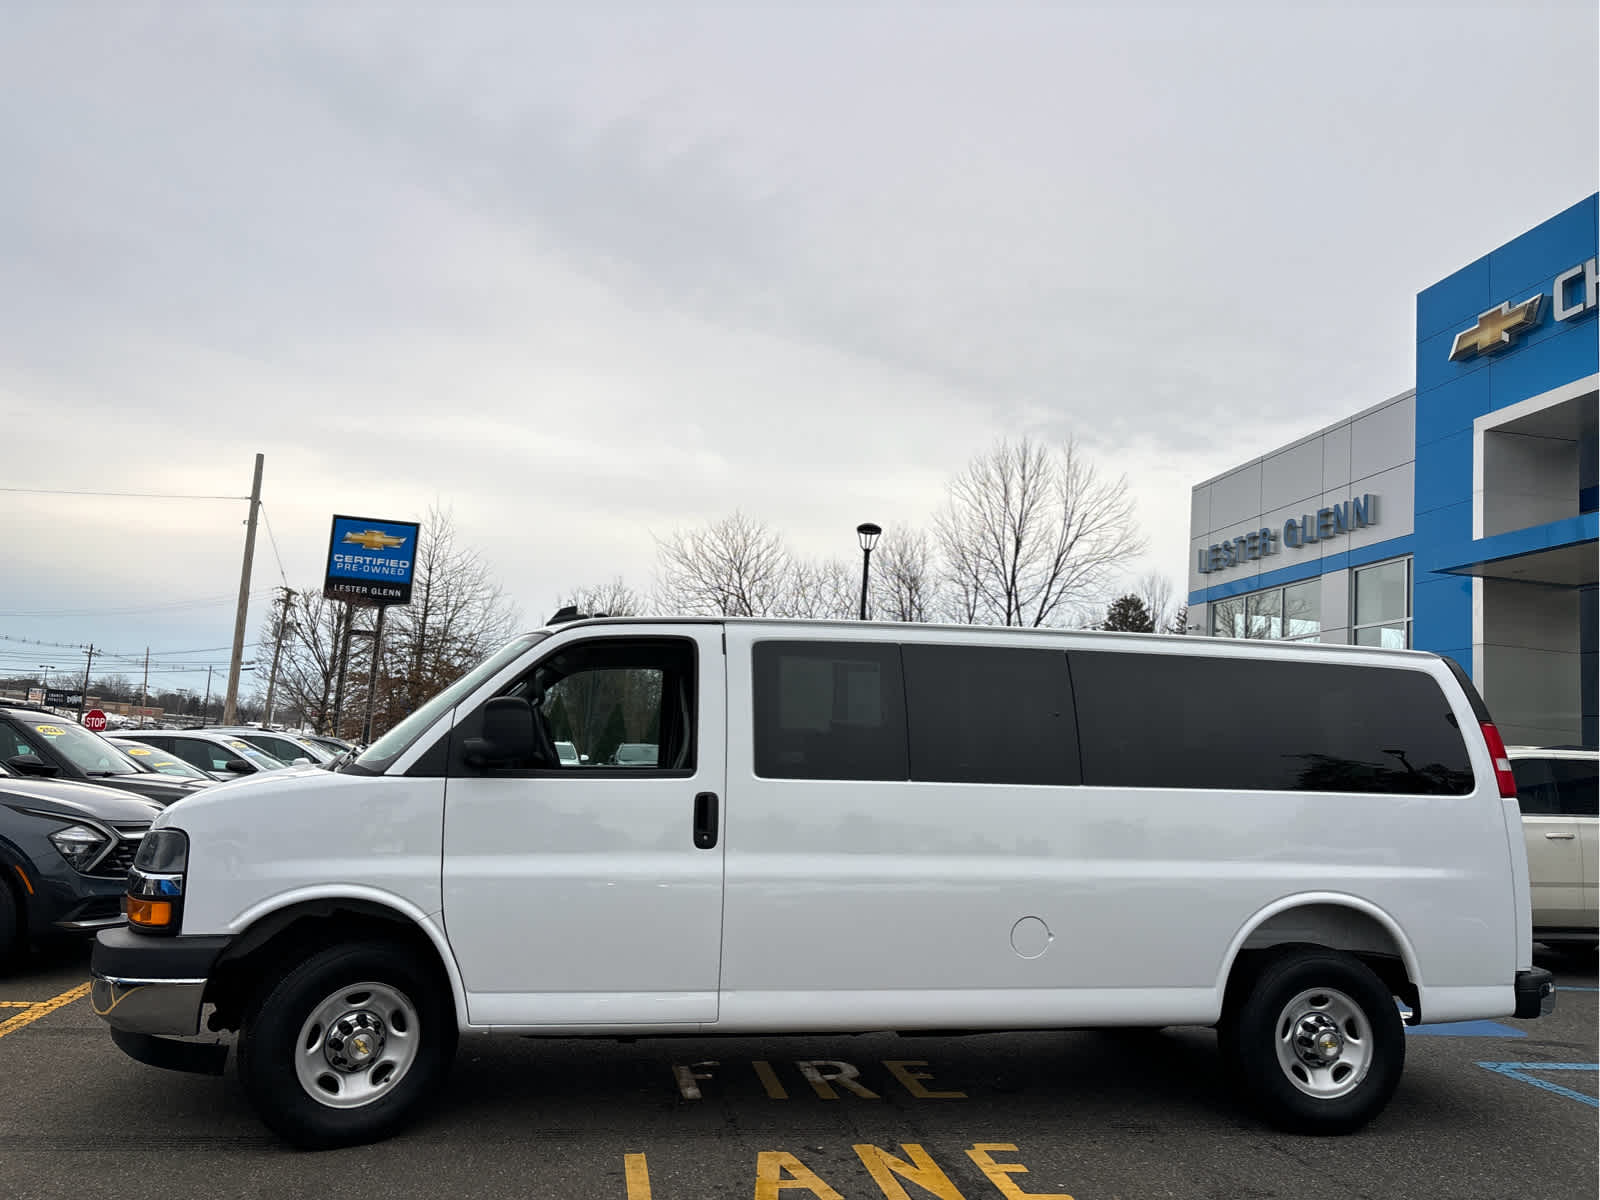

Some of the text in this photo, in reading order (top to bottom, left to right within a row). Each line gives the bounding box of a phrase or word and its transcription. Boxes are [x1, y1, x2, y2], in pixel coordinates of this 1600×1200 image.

[1198, 494, 1377, 573] LESTER GLENN
[334, 554, 409, 568] CERTIFIED
[336, 562, 404, 576] PRE-OWNED
[334, 584, 401, 597] LESTER GLENN
[86, 717, 106, 728] STOP
[673, 1060, 968, 1099] FIRE
[623, 1143, 1075, 1200] LANE
